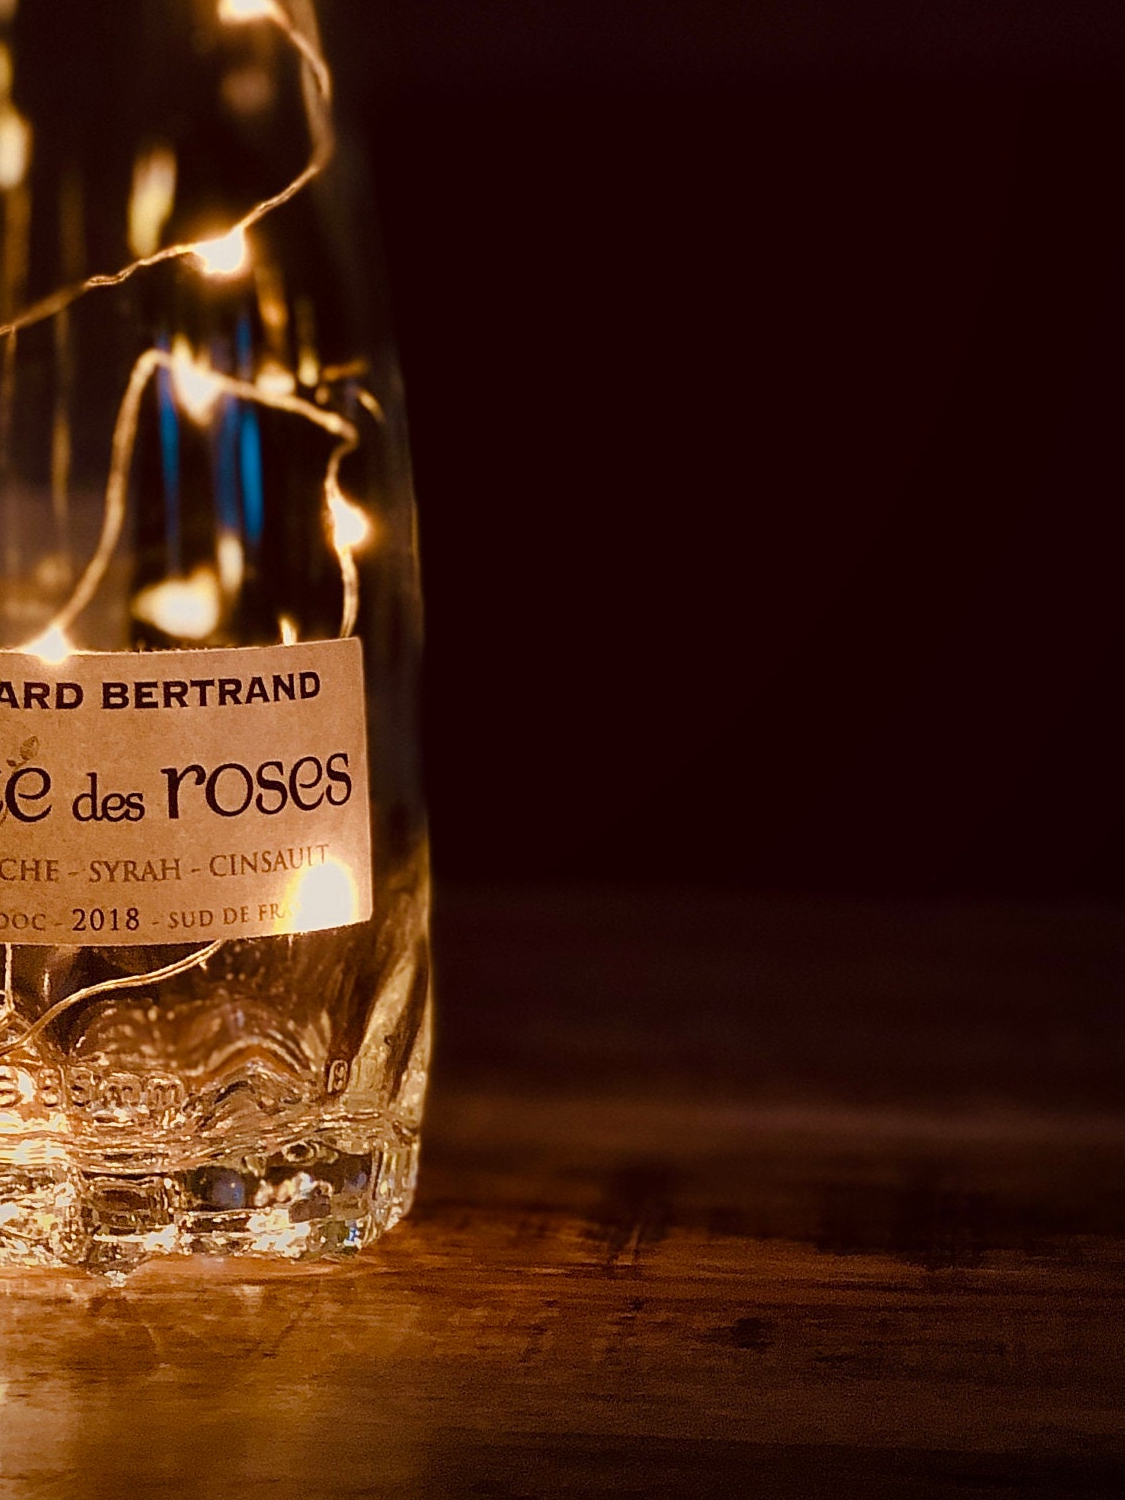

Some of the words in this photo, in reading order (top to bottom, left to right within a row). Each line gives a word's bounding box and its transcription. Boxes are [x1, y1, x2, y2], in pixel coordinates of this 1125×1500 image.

[101, 670, 321, 710] BERTRAND
[71, 771, 146, 823] des
[160, 752, 353, 820] roses
[88, 858, 182, 884] SYRAH
[72, 907, 140, 931] 2018
[168, 910, 213, 930] SUD
[223, 905, 250, 925] DE
